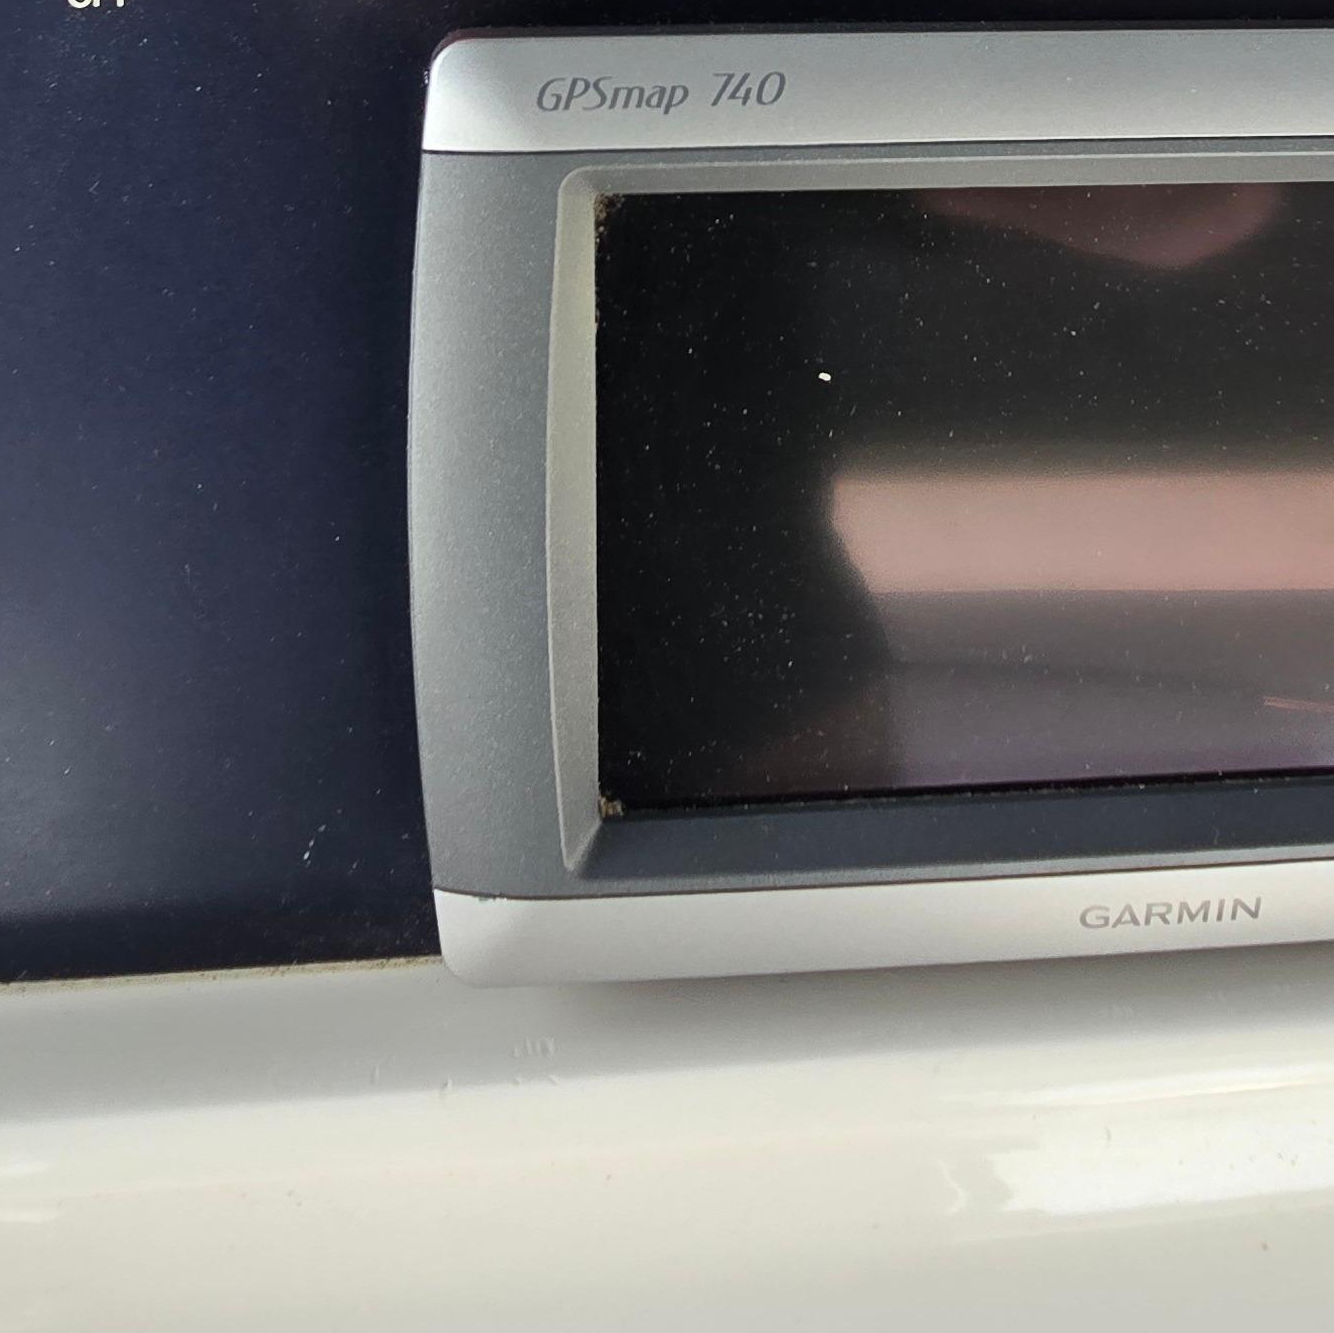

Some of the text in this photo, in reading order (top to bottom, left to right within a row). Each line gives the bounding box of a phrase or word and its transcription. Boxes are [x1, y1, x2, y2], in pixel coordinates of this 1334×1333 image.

[536, 71, 787, 115] GPSmap 740
[1079, 896, 1262, 929] GARMIN
